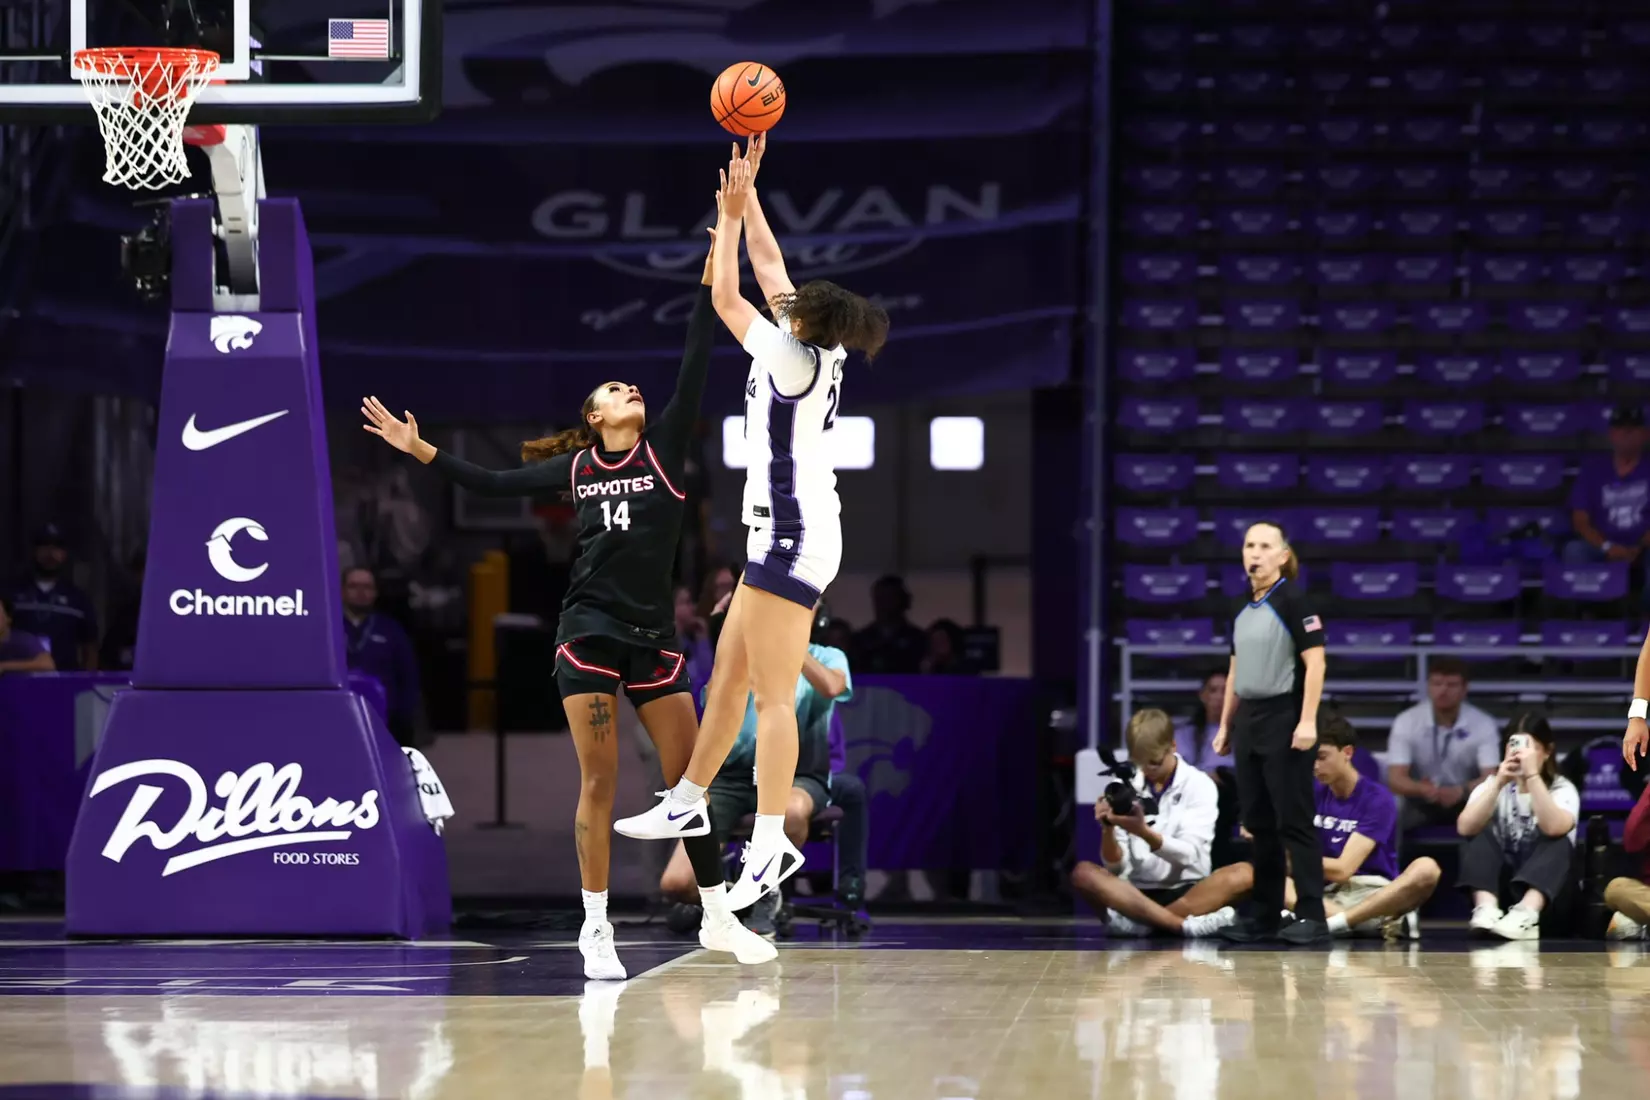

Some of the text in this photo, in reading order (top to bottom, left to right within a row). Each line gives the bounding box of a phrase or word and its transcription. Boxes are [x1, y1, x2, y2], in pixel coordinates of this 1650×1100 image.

[530, 181, 1002, 239] GLVAN
[576, 475, 654, 499] COYOTES
[600, 500, 631, 532] 14
[89, 759, 380, 863] Dillons
[273, 853, 360, 865] FOOD STORES
